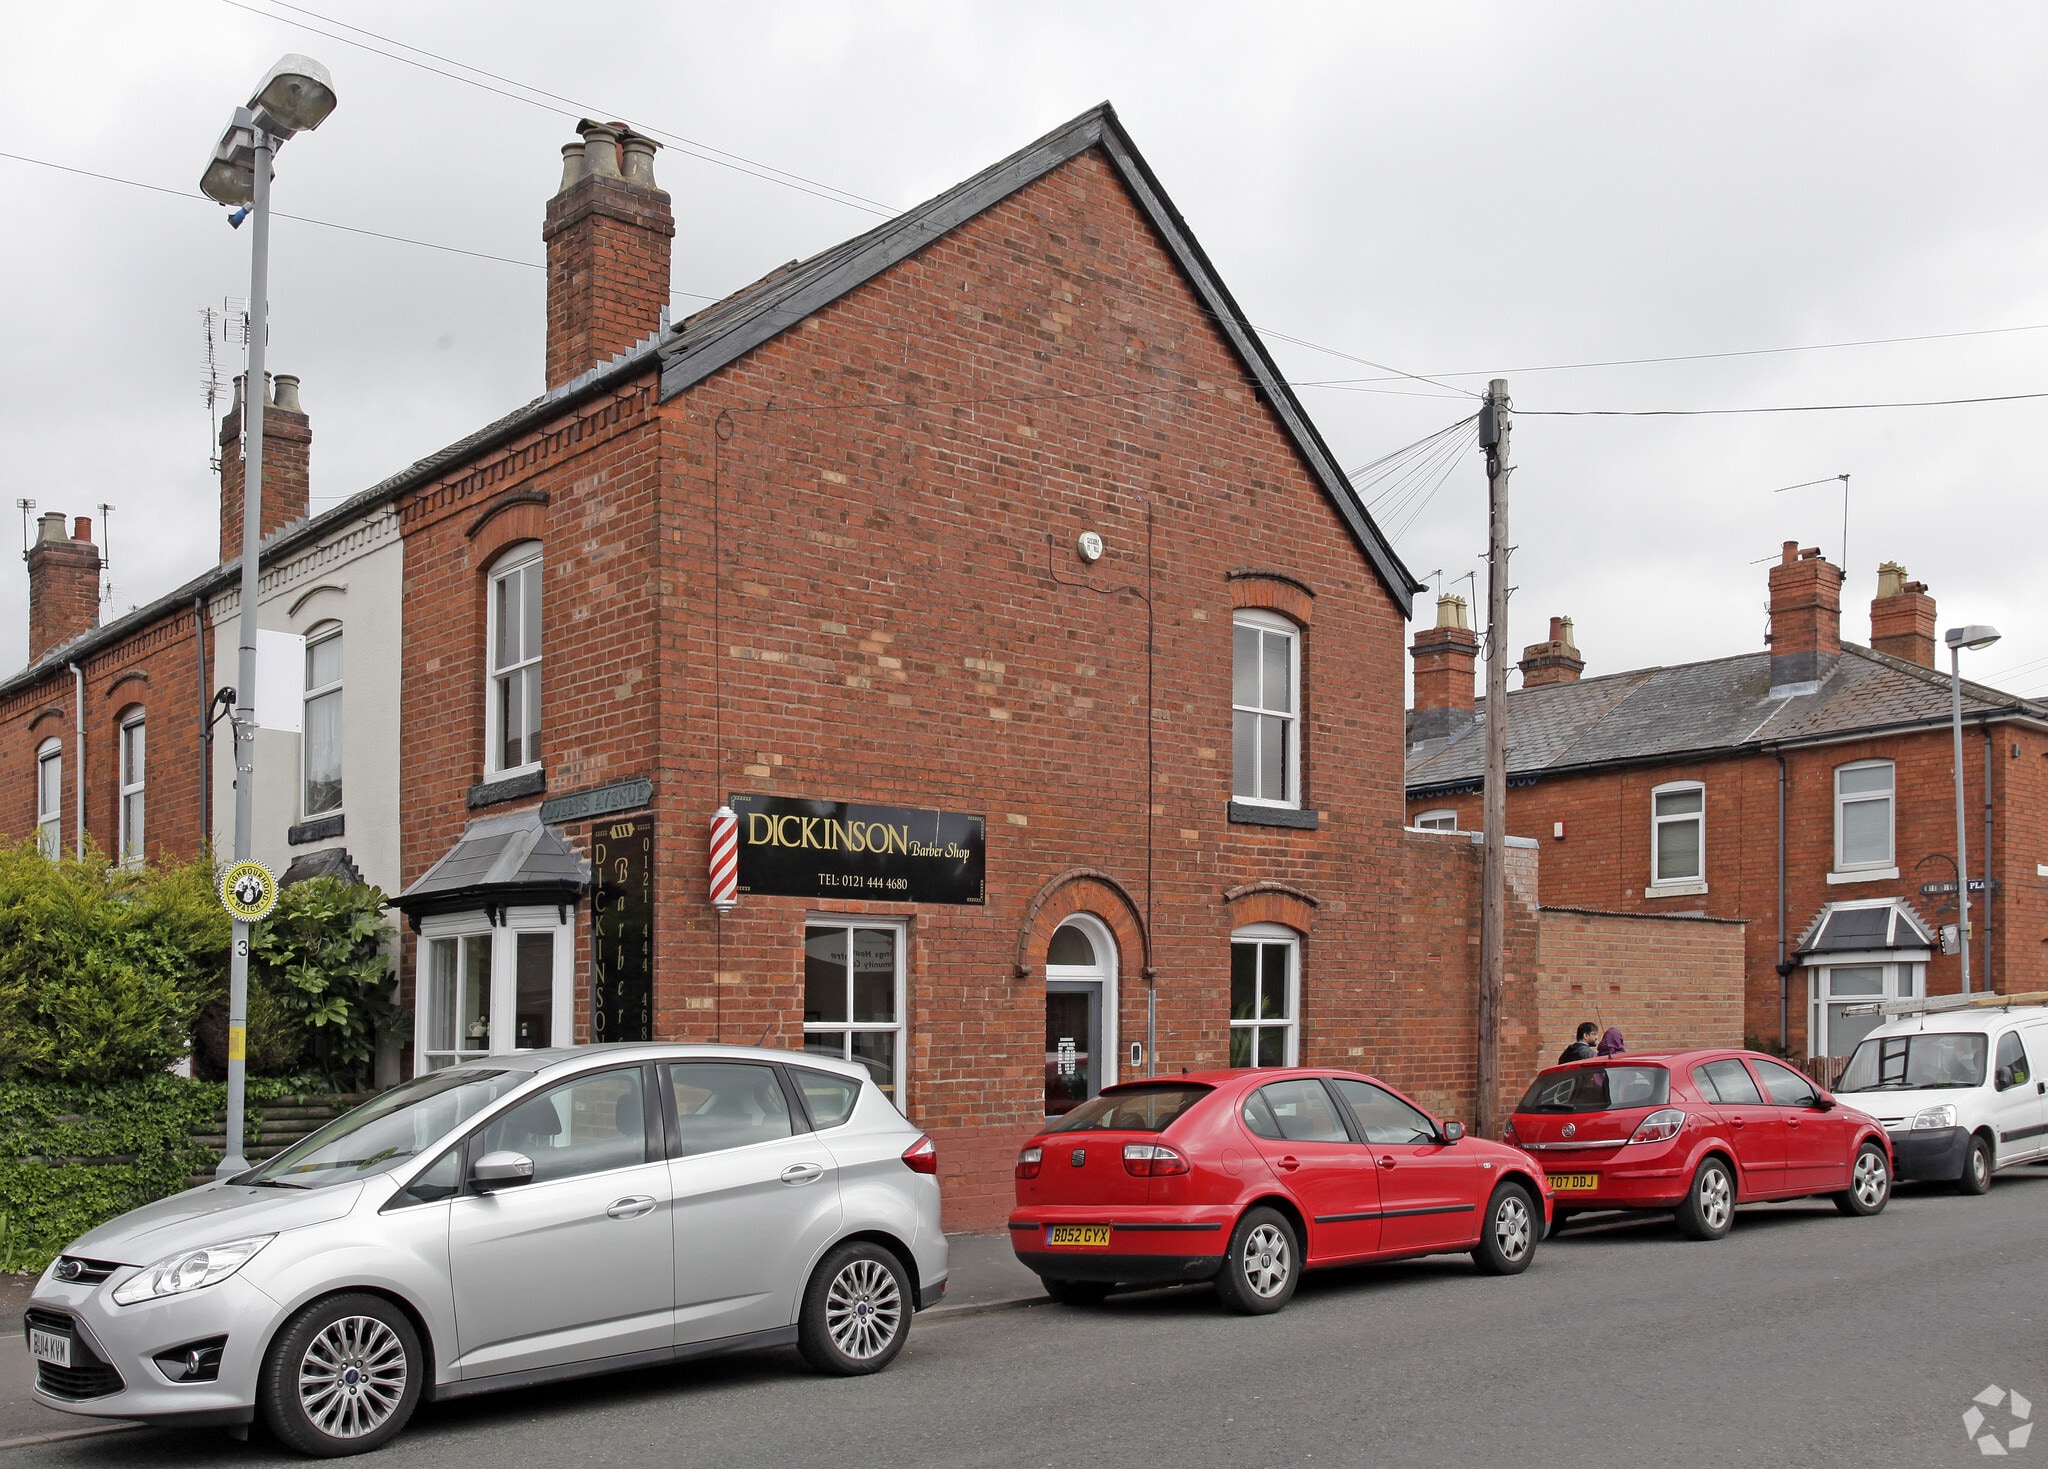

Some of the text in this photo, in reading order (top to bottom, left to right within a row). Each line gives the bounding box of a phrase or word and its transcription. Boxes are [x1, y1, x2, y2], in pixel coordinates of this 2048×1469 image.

[543, 784, 646, 820] QUEENS AVENUE
[747, 812, 970, 864] DICKINSON Barber Shop
[642, 837, 650, 904] 0121
[818, 873, 908, 890] TEL: 0121 444 4680
[228, 867, 271, 901] NEIGHBOURHOOD
[235, 901, 261, 912] WATCH
[237, 940, 248, 957] 3
[640, 991, 648, 1041] 468
[1547, 1176, 1594, 1188] T07 DDJ
[1053, 1228, 1108, 1243] BD52 GYX
